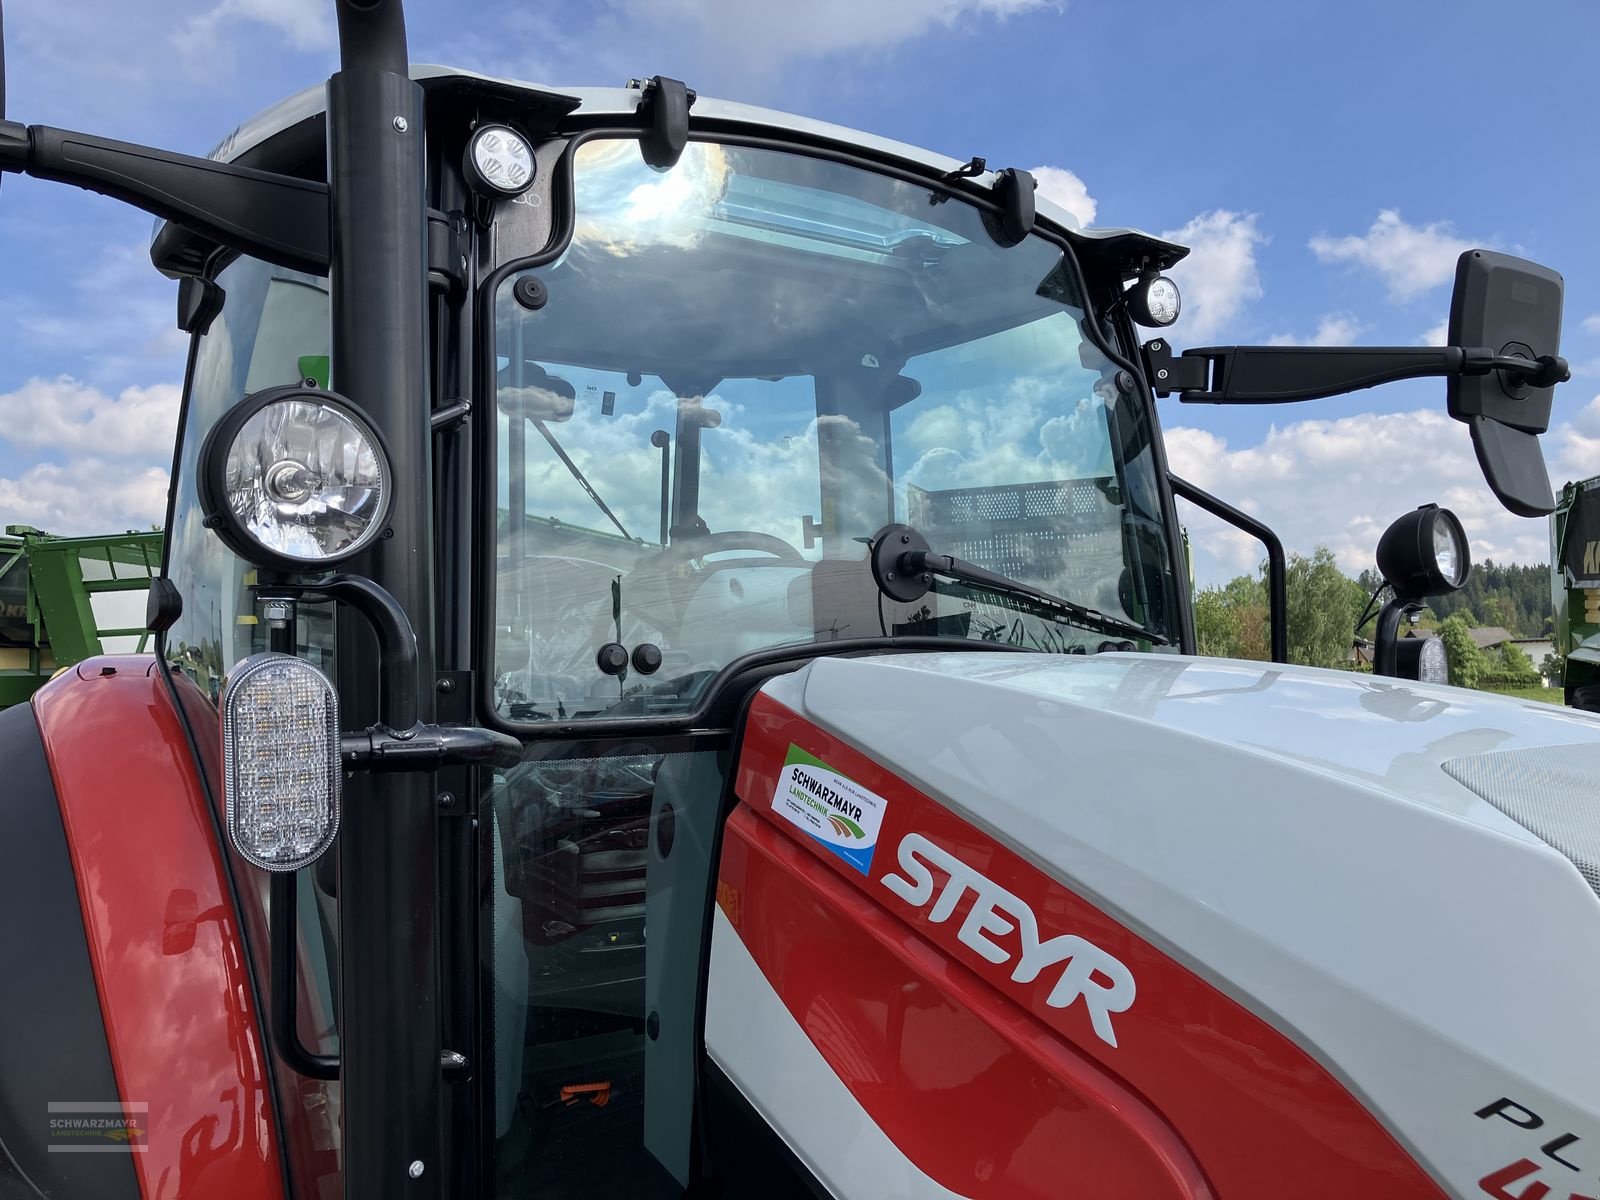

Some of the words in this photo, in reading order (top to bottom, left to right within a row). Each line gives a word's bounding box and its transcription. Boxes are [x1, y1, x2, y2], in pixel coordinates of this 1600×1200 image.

[1584, 540, 1600, 574] K
[789, 784, 829, 817] LANDTECHNIK
[791, 767, 862, 822] SCHWARZMAYR
[880, 832, 1136, 1048] STEYR
